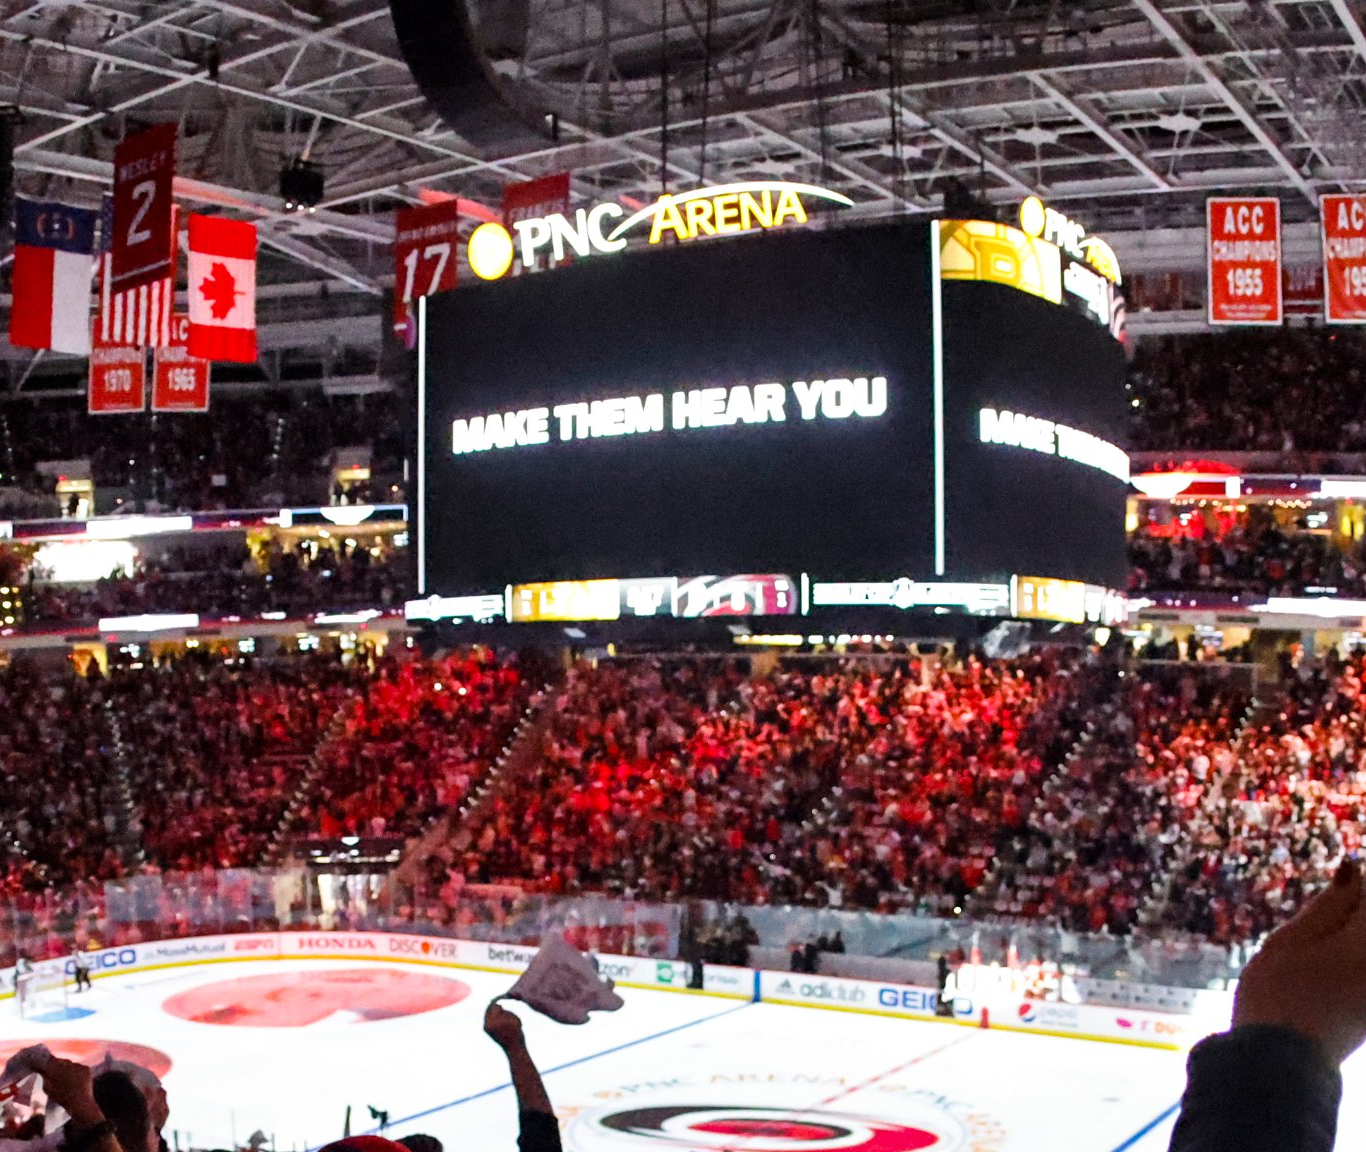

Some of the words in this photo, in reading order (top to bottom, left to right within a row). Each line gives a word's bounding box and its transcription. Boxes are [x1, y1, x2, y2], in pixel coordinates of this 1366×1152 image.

[119, 153, 166, 180] WESLEY
[125, 179, 156, 246] 2
[1224, 206, 1264, 234] ACC
[514, 203, 627, 267] PNC
[648, 190, 808, 244] ARENA
[1212, 240, 1276, 262] CHAMPIONS
[403, 243, 451, 303] 17
[1226, 268, 1264, 296] 1955
[103, 368, 132, 391] 1970
[168, 367, 196, 391] 1965
[452, 407, 549, 454] MAKE
[553, 393, 664, 441] THEM
[671, 383, 786, 430] HEAR
[792, 376, 888, 420] YOU
[979, 407, 1056, 455] MAKE
[298, 937, 376, 950] HONDA
[388, 937, 459, 958] DISCOVER
[878, 988, 974, 1015] GEIO
